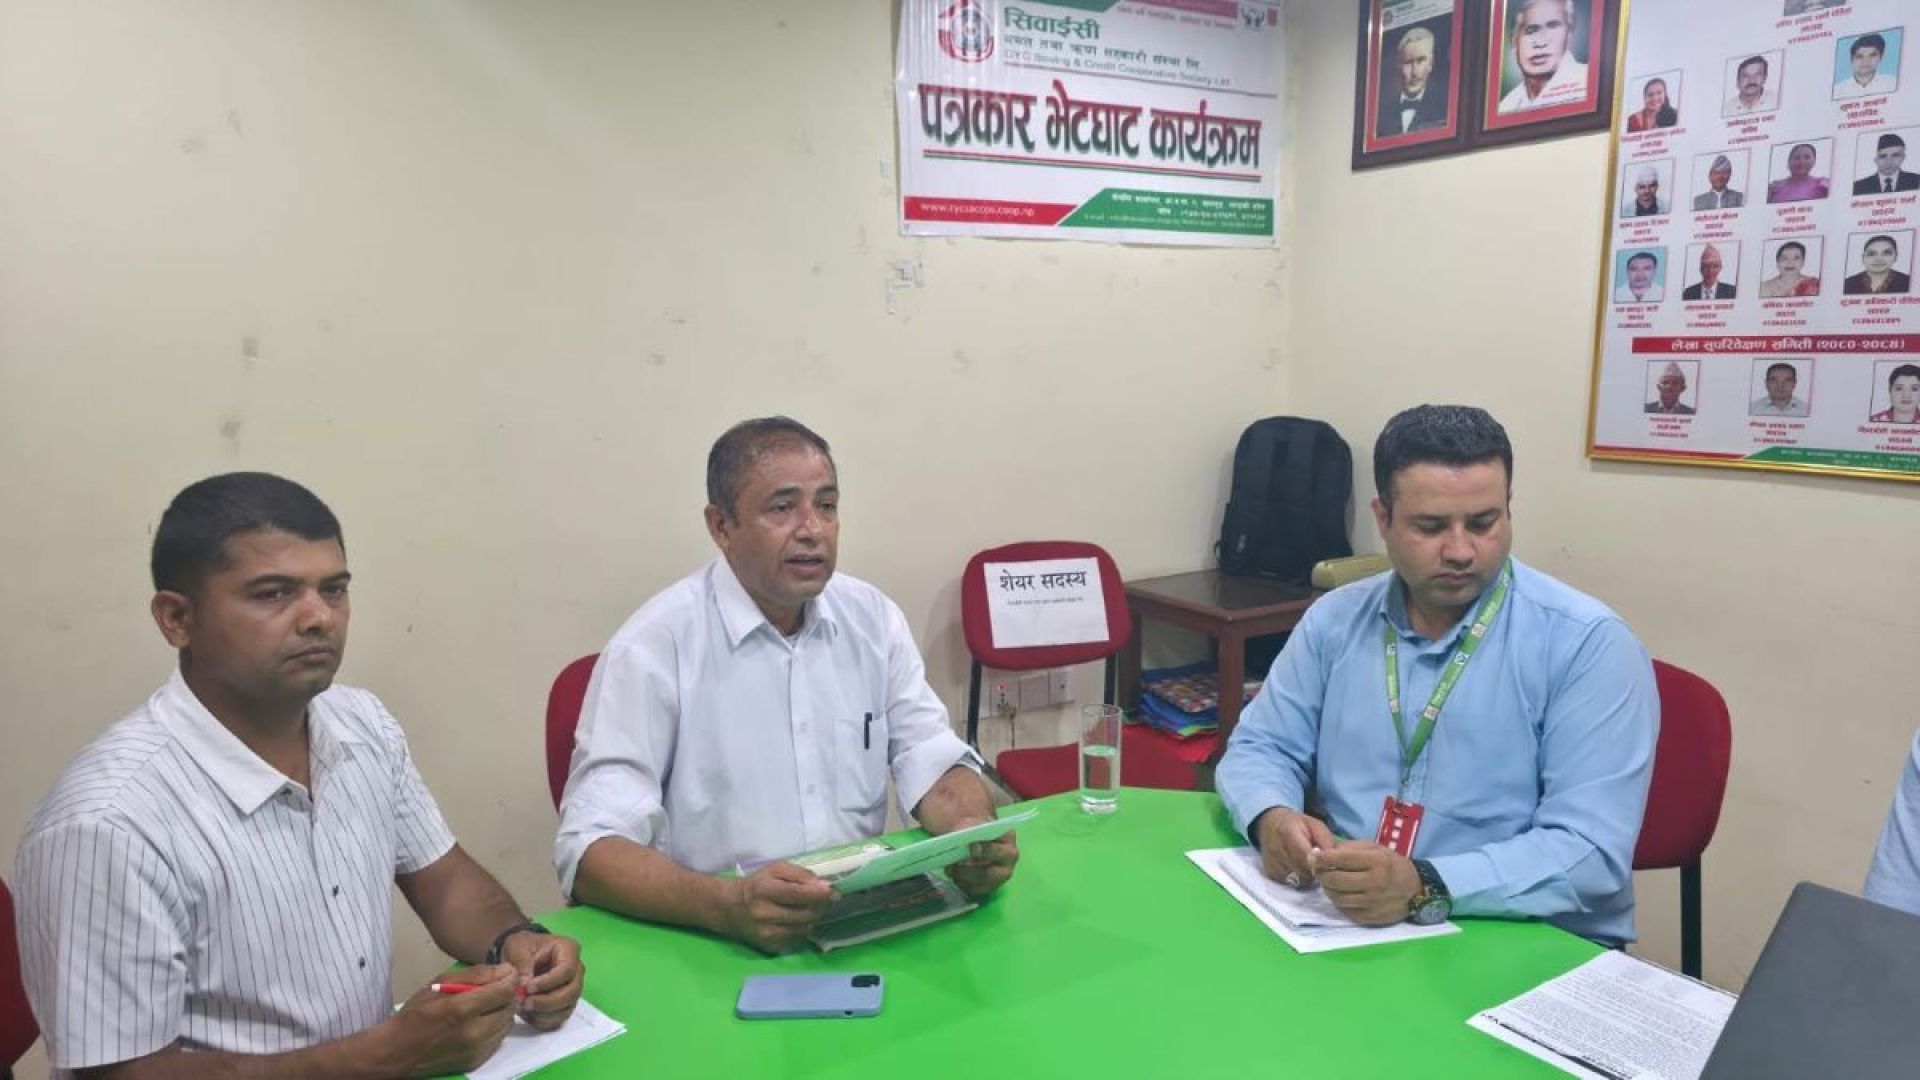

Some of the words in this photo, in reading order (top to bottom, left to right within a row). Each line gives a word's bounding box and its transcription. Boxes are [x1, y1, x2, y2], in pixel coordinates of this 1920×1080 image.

[1004, 7, 1100, 39] सिवाईसी
[918, 84, 1037, 153] पत्रकार
[1046, 79, 1143, 158] भेटघाट
[1150, 99, 1262, 168] कार्यक्रम
[1000, 569, 1036, 592] शेयर
[1040, 571, 1087, 589] सदस्य
